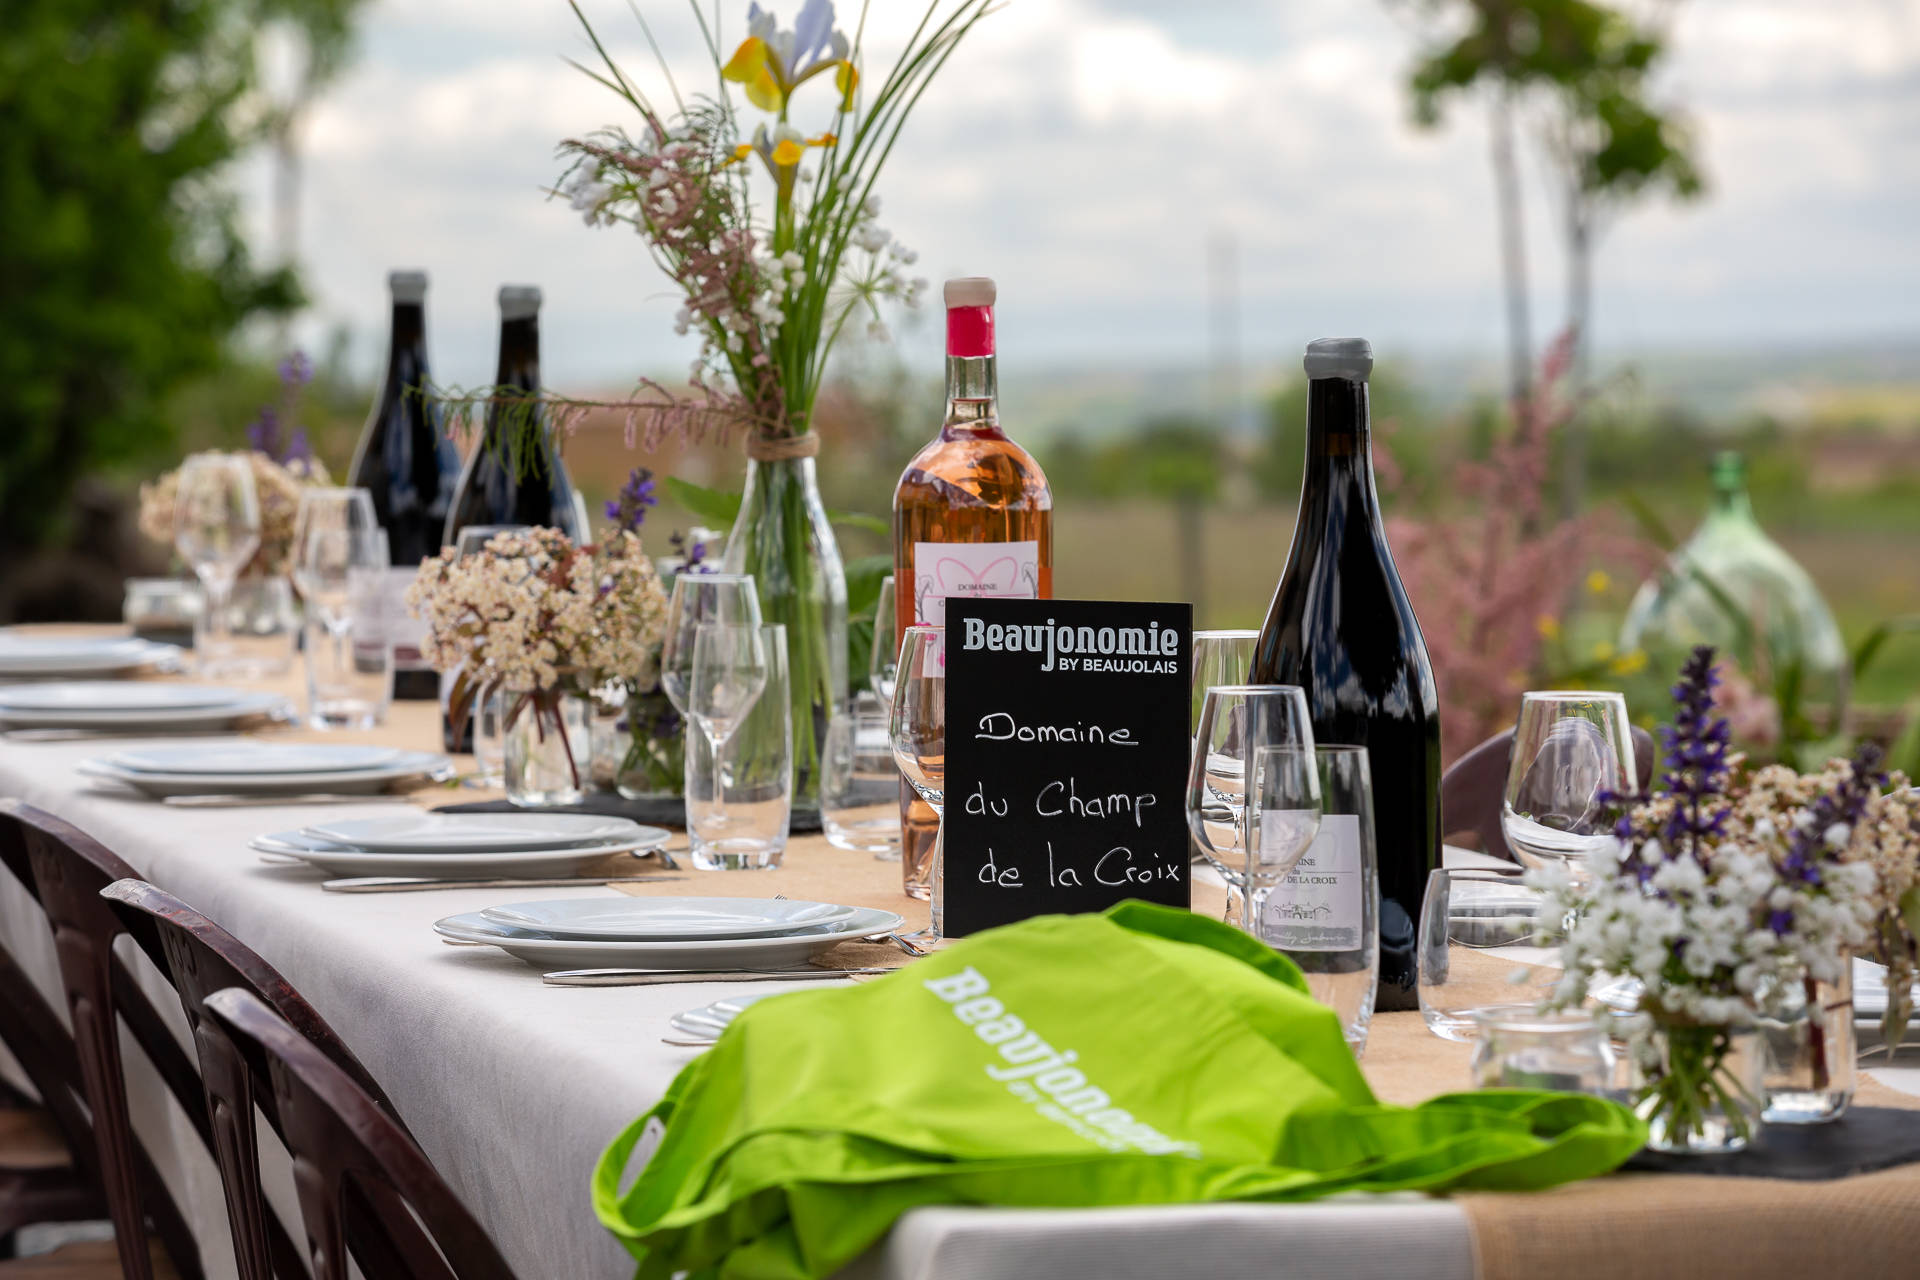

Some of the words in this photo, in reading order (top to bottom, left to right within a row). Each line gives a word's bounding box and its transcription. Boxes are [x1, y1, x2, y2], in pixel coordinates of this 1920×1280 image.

[957, 583, 998, 591] DOMAINE
[962, 617, 1179, 672] Beaujonomie
[1059, 657, 1079, 671] BY
[1083, 659, 1178, 674] BEAUJOLAIS
[975, 712, 1139, 745] Domaine
[965, 781, 1008, 817] du
[1036, 777, 1156, 828] Champ
[978, 847, 1023, 887] de
[1047, 841, 1082, 887] la
[1094, 846, 1180, 885] Croix
[1287, 876, 1298, 884] DE
[1299, 876, 1310, 884] LA
[1311, 876, 1337, 885] CROIX
